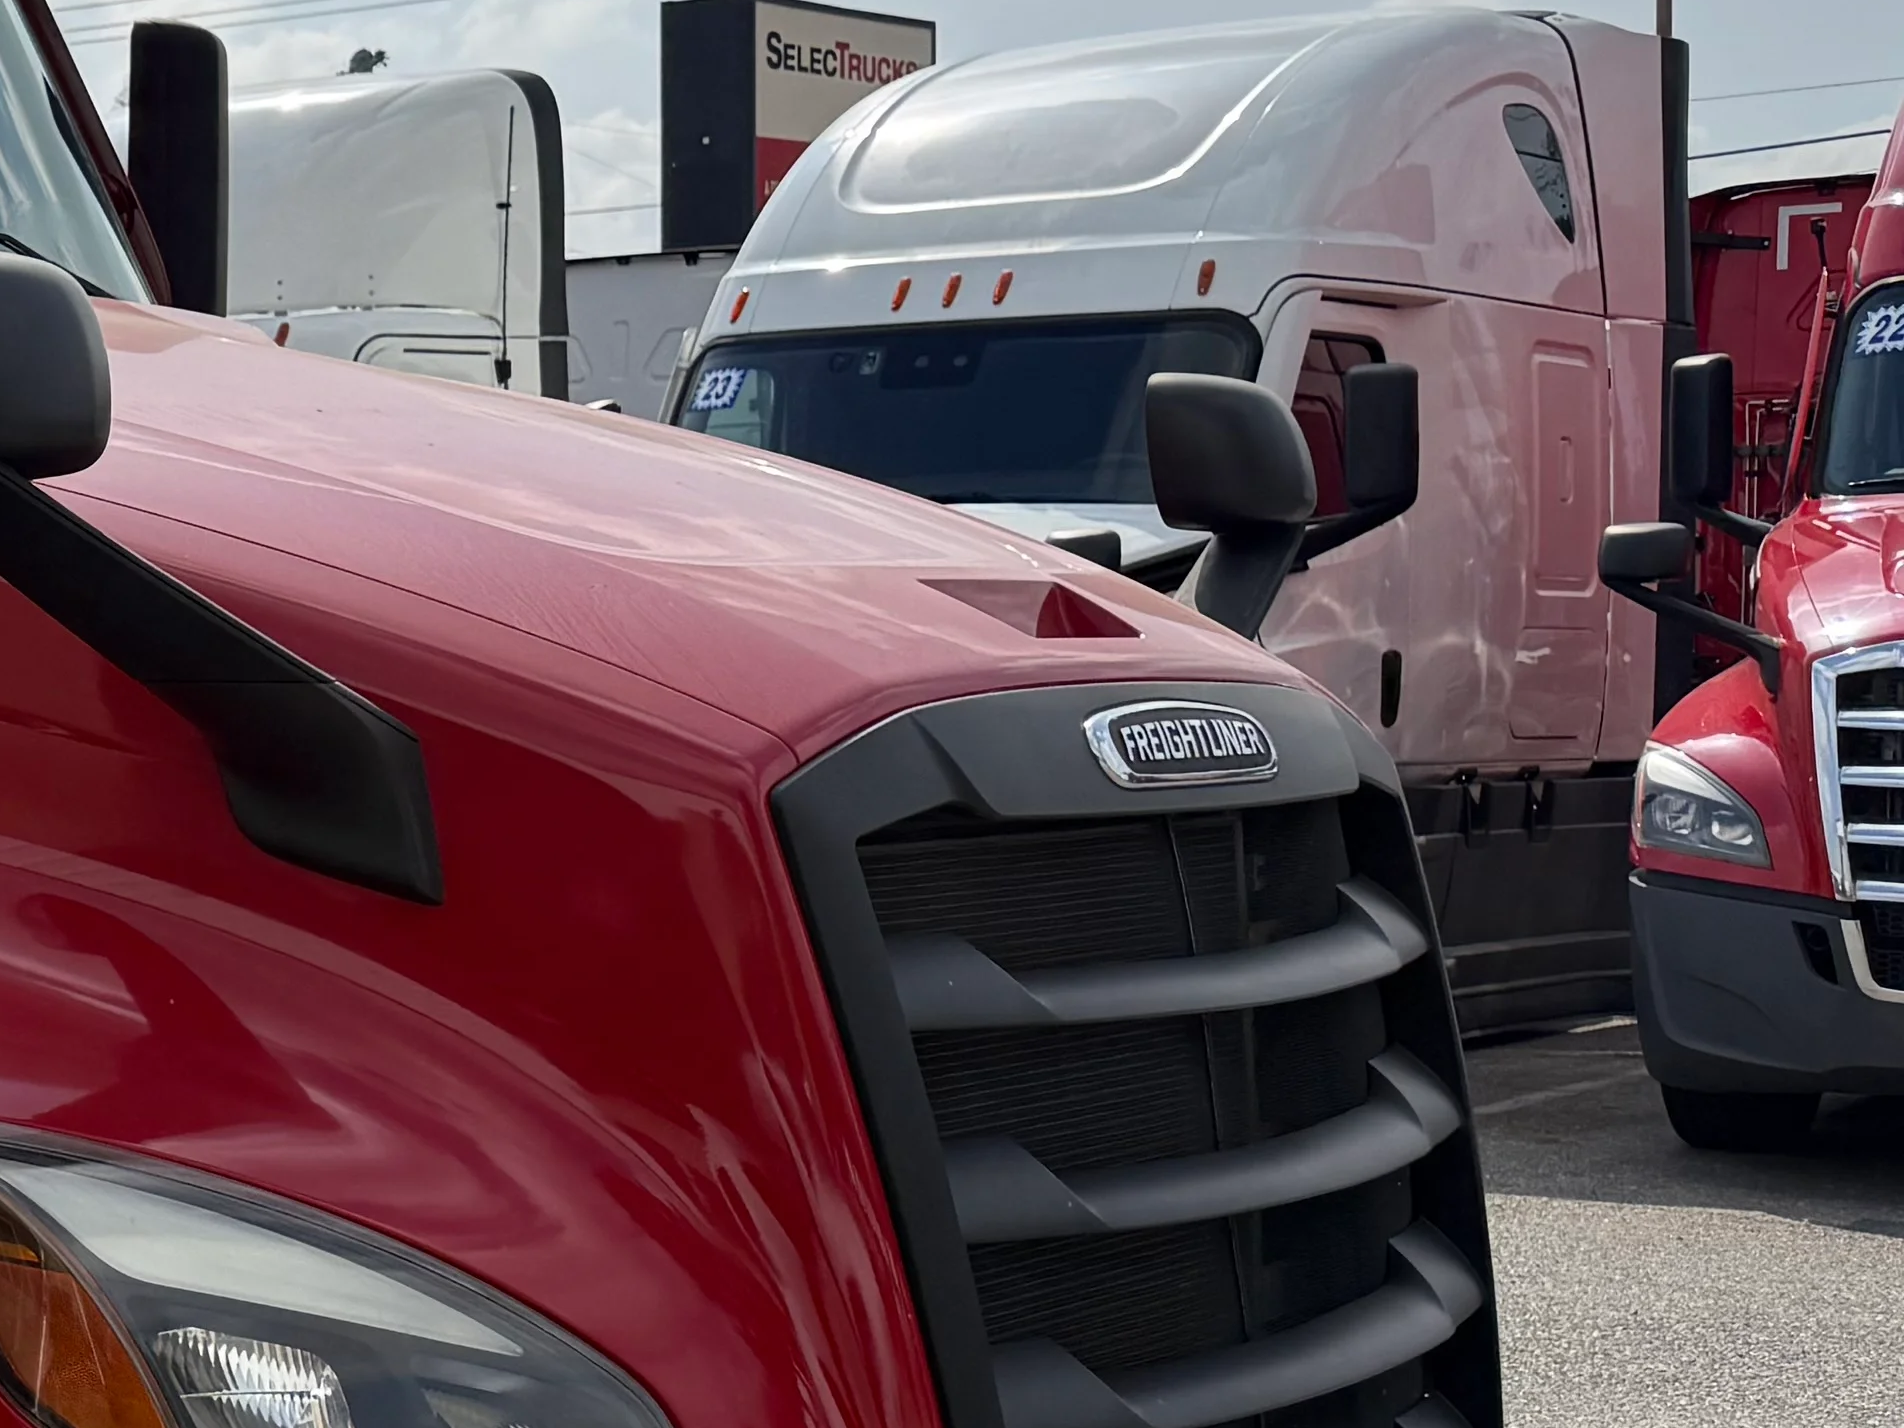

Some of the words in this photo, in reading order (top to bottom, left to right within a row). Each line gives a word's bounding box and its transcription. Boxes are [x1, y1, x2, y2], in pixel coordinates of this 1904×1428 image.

[1868, 313, 1904, 344] 22
[701, 375, 732, 401] 23
[1120, 719, 1265, 762] FREIGHTLINER
